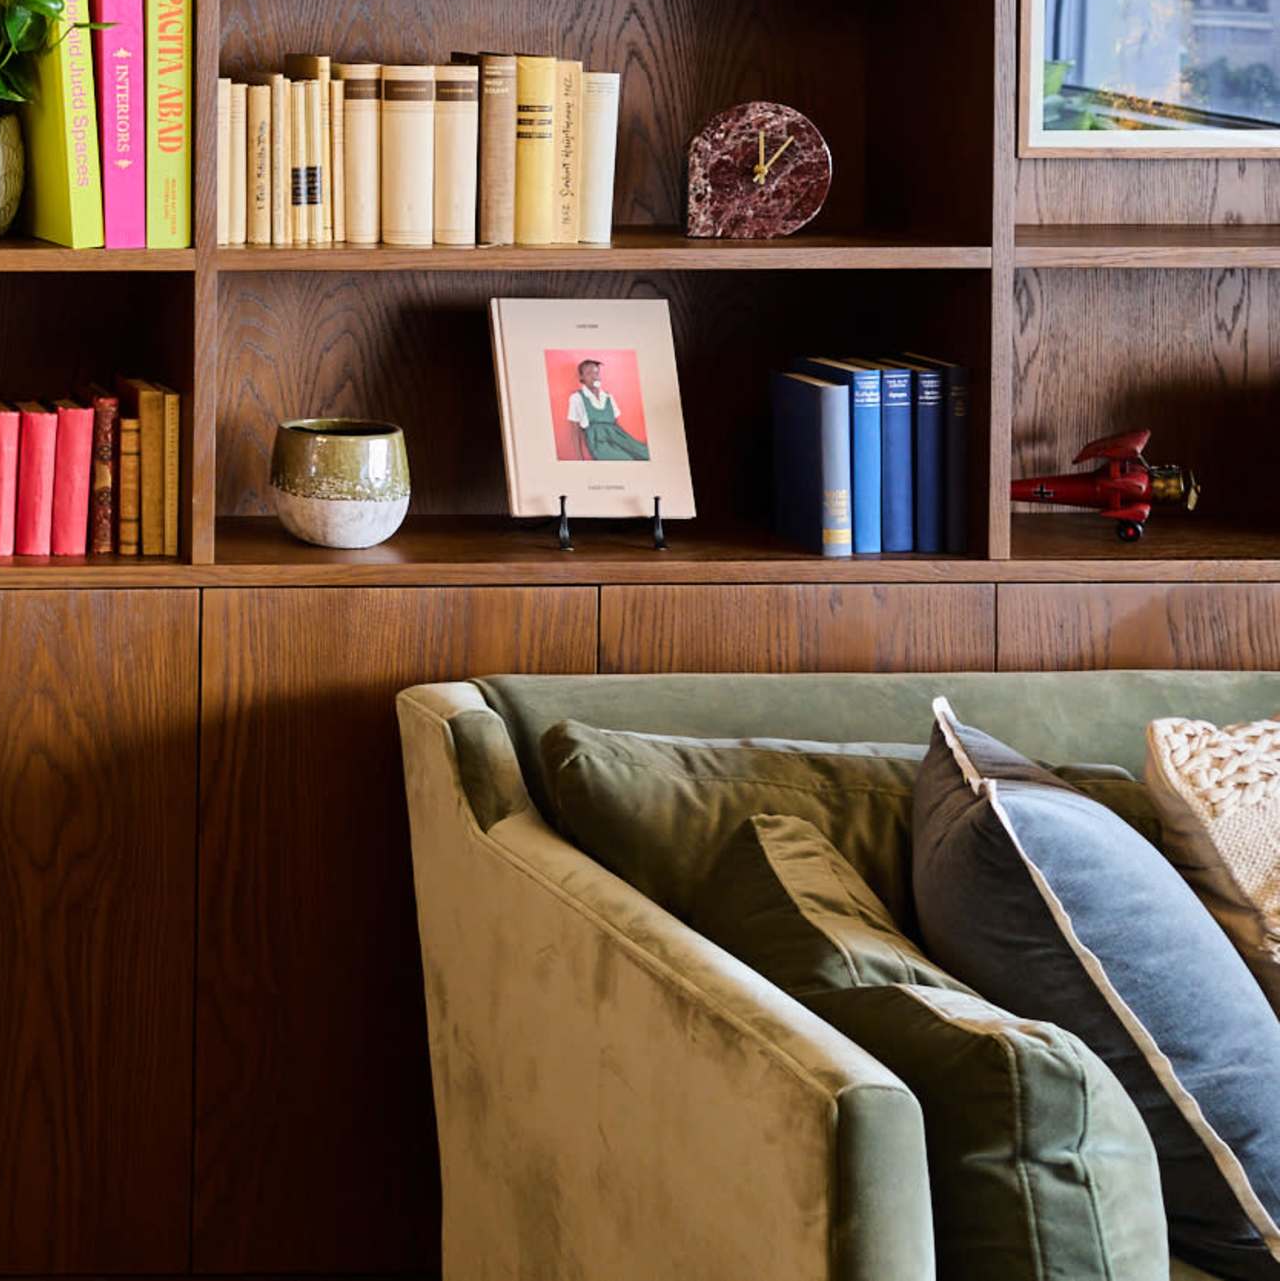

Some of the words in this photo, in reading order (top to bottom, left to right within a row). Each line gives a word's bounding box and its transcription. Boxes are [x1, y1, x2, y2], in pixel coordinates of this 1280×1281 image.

[69, 62, 87, 110] Judd
[115, 64, 131, 153] INTERIORS
[157, 83, 184, 154] ABAD
[72, 115, 89, 187] Spaces
